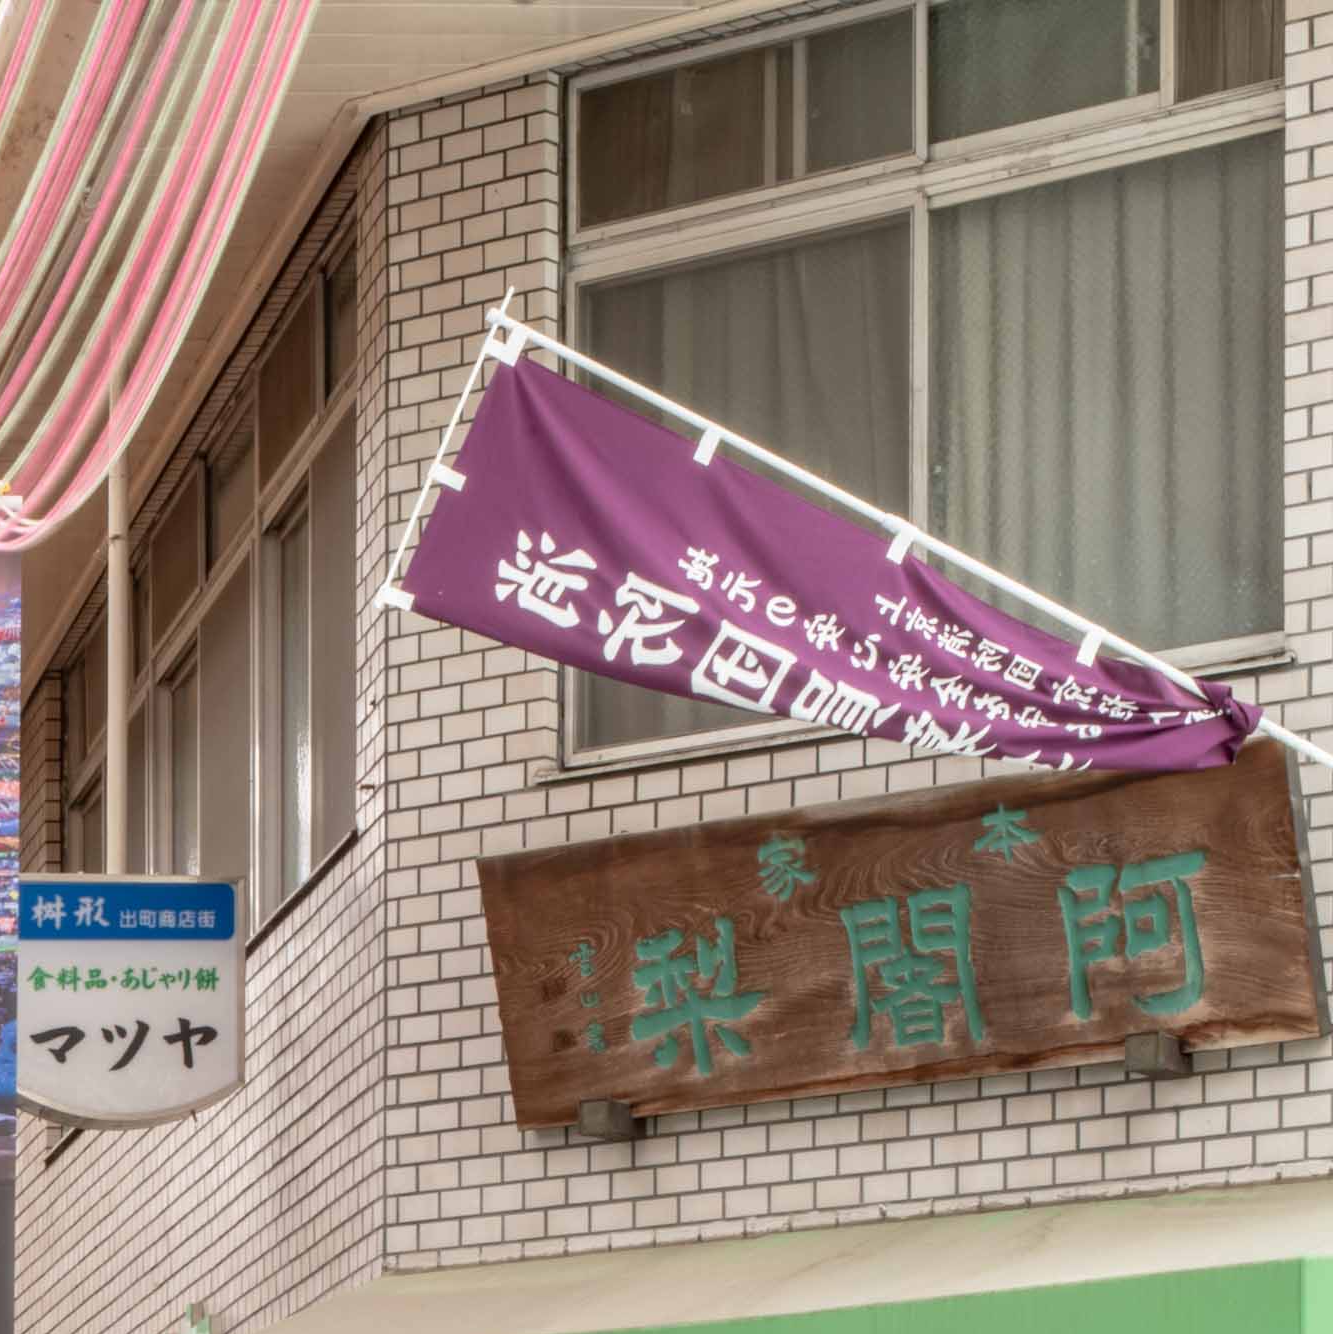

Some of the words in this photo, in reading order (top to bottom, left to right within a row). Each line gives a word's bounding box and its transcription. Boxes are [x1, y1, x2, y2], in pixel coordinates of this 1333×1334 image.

[31, 894, 110, 930] 桝形
[119, 909, 217, 929] 出町商店街
[27, 966, 220, 992] 食料品・あじゃり餅
[29, 1018, 218, 1072] マツヤ
